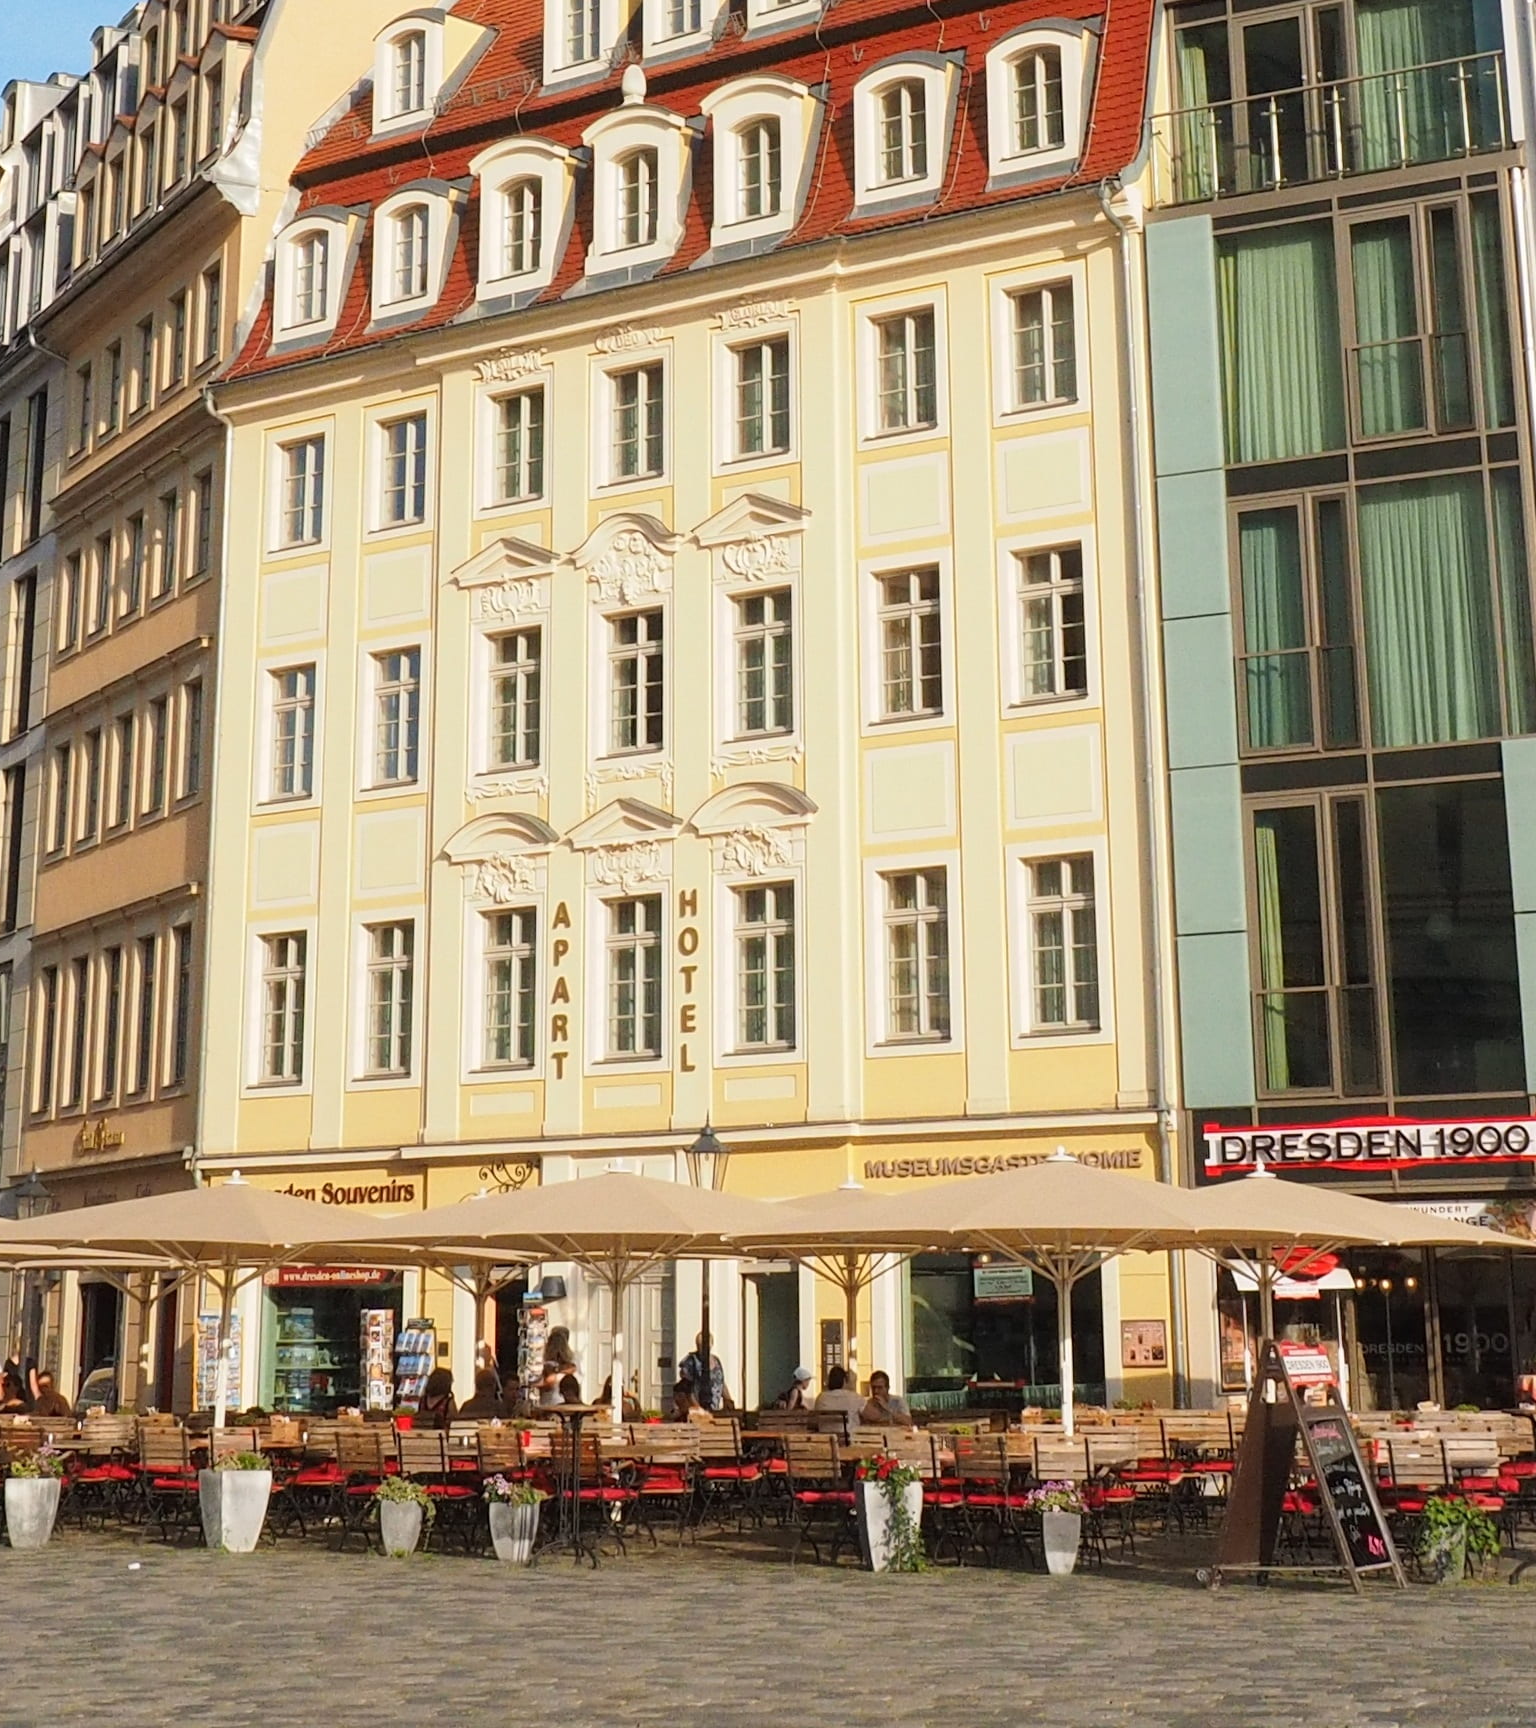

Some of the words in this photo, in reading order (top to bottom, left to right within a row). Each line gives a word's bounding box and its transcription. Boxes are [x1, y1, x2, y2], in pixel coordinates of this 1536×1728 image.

[551, 902, 571, 1080] APART
[678, 889, 699, 1072] HOTEL
[1220, 1129, 1423, 1164] DRESDEN
[1436, 1125, 1530, 1156] 1900
[864, 1149, 1143, 1179] MUSEUMSGASTOMIE
[321, 1179, 415, 1205] Souvenirs
[1362, 1343, 1425, 1355] DRESDEN
[1443, 1332, 1509, 1354] 1900
